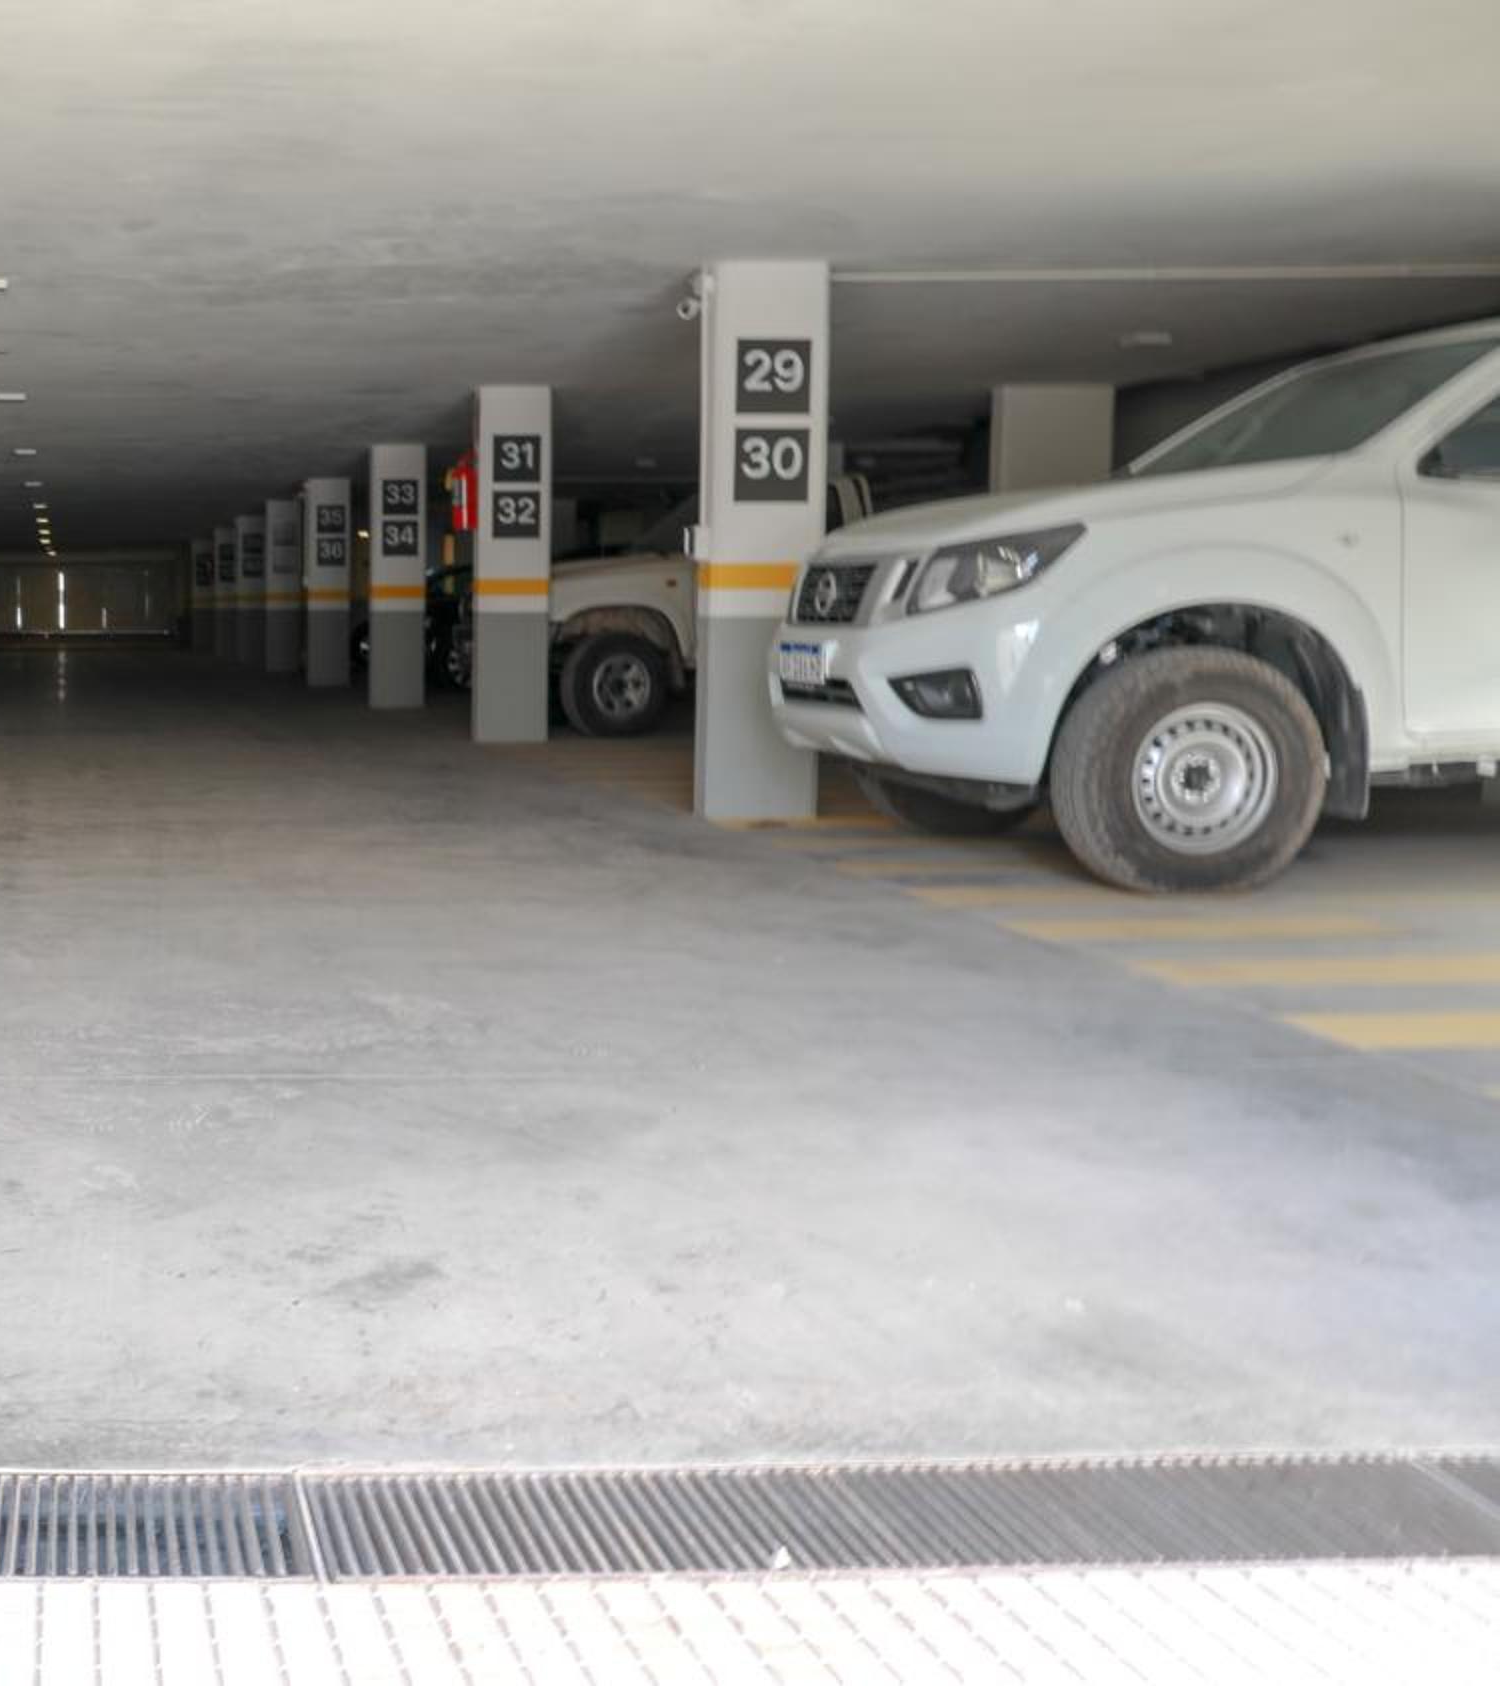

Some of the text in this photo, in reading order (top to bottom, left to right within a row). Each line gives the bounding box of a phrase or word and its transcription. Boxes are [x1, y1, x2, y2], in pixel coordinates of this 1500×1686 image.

[743, 349, 804, 392] 29
[501, 441, 534, 469] 31
[741, 437, 803, 480] 30
[386, 483, 415, 505] 33
[319, 508, 343, 526] 35
[498, 497, 535, 524] 32
[385, 525, 414, 546] 34
